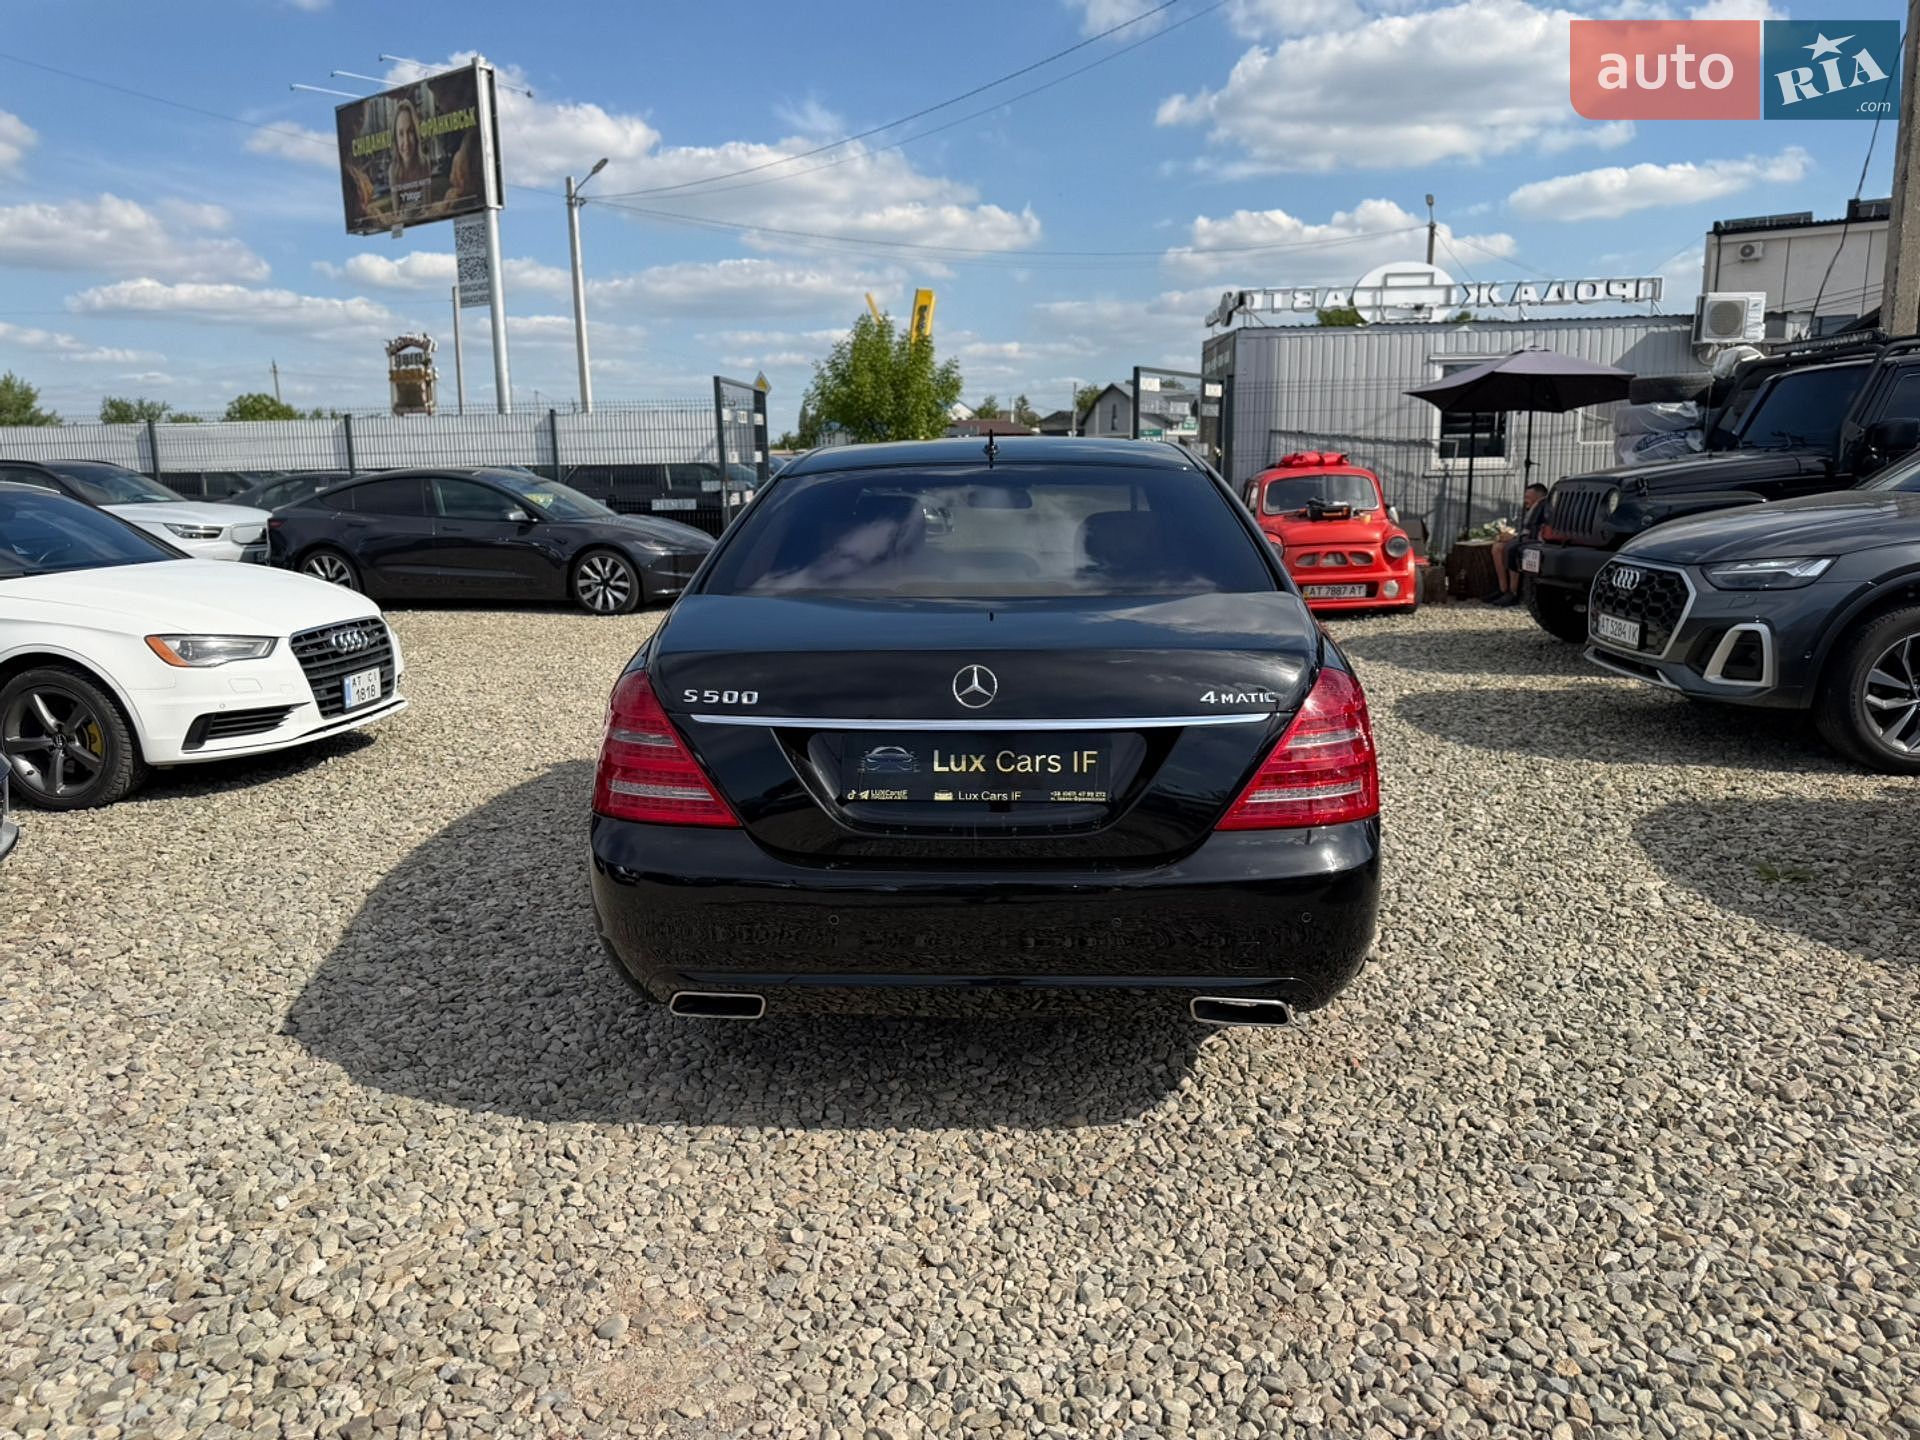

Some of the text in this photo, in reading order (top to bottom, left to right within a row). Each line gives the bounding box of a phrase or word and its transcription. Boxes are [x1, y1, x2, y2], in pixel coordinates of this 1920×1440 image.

[1310, 587, 1323, 596] AT
[1349, 585, 1365, 595] AT
[1600, 616, 1639, 643] AT 5284 IK
[352, 675, 361, 687] AT
[356, 683, 376, 702] 1818
[1199, 690, 1277, 704] 4MATIC
[932, 749, 1099, 773] Lux Cars IF
[958, 790, 1023, 801] Lux Cars IF
